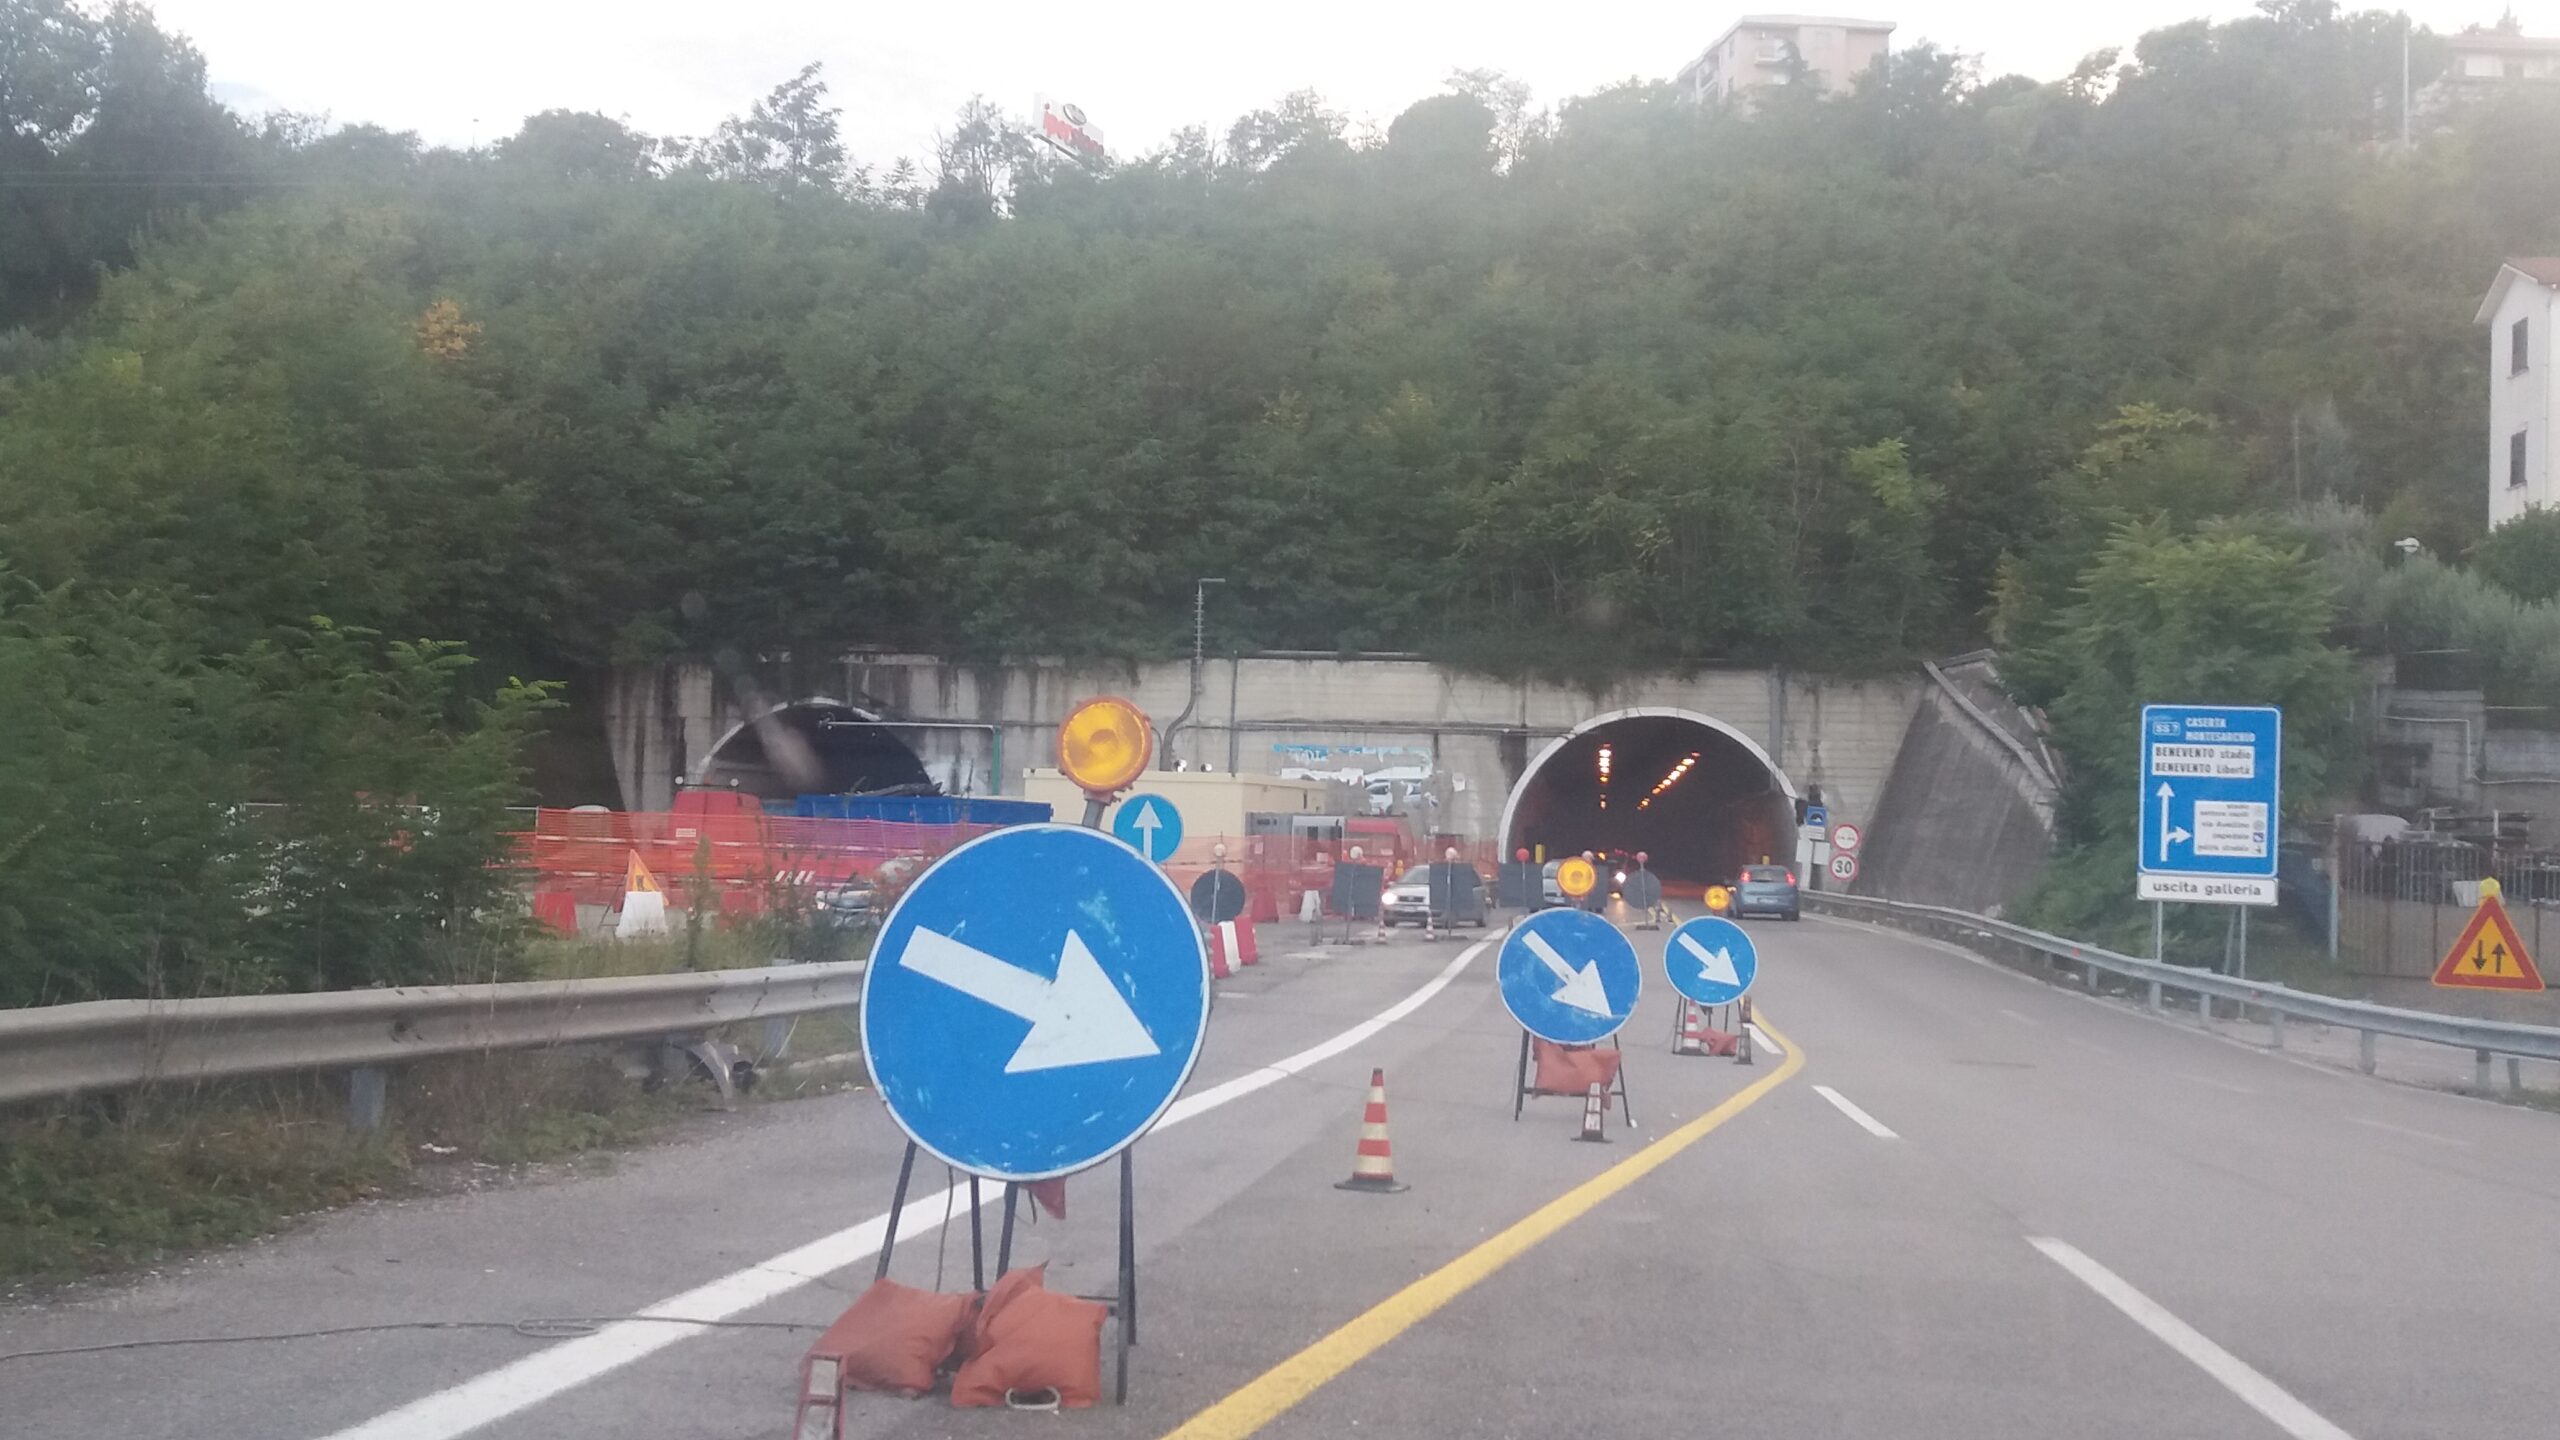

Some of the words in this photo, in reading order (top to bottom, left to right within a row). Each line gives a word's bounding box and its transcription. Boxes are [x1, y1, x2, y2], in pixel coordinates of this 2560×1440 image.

[2155, 724, 2170, 733] SS
[2185, 717, 2227, 728] CASERTA
[2155, 746, 2215, 759] BENEVENTO
[2220, 748, 2252, 760] stadio
[2155, 761, 2212, 774] BENEVENTO
[1835, 860, 1853, 874] 30
[2153, 881, 2198, 893] uscita
[2204, 883, 2261, 896] galleria
